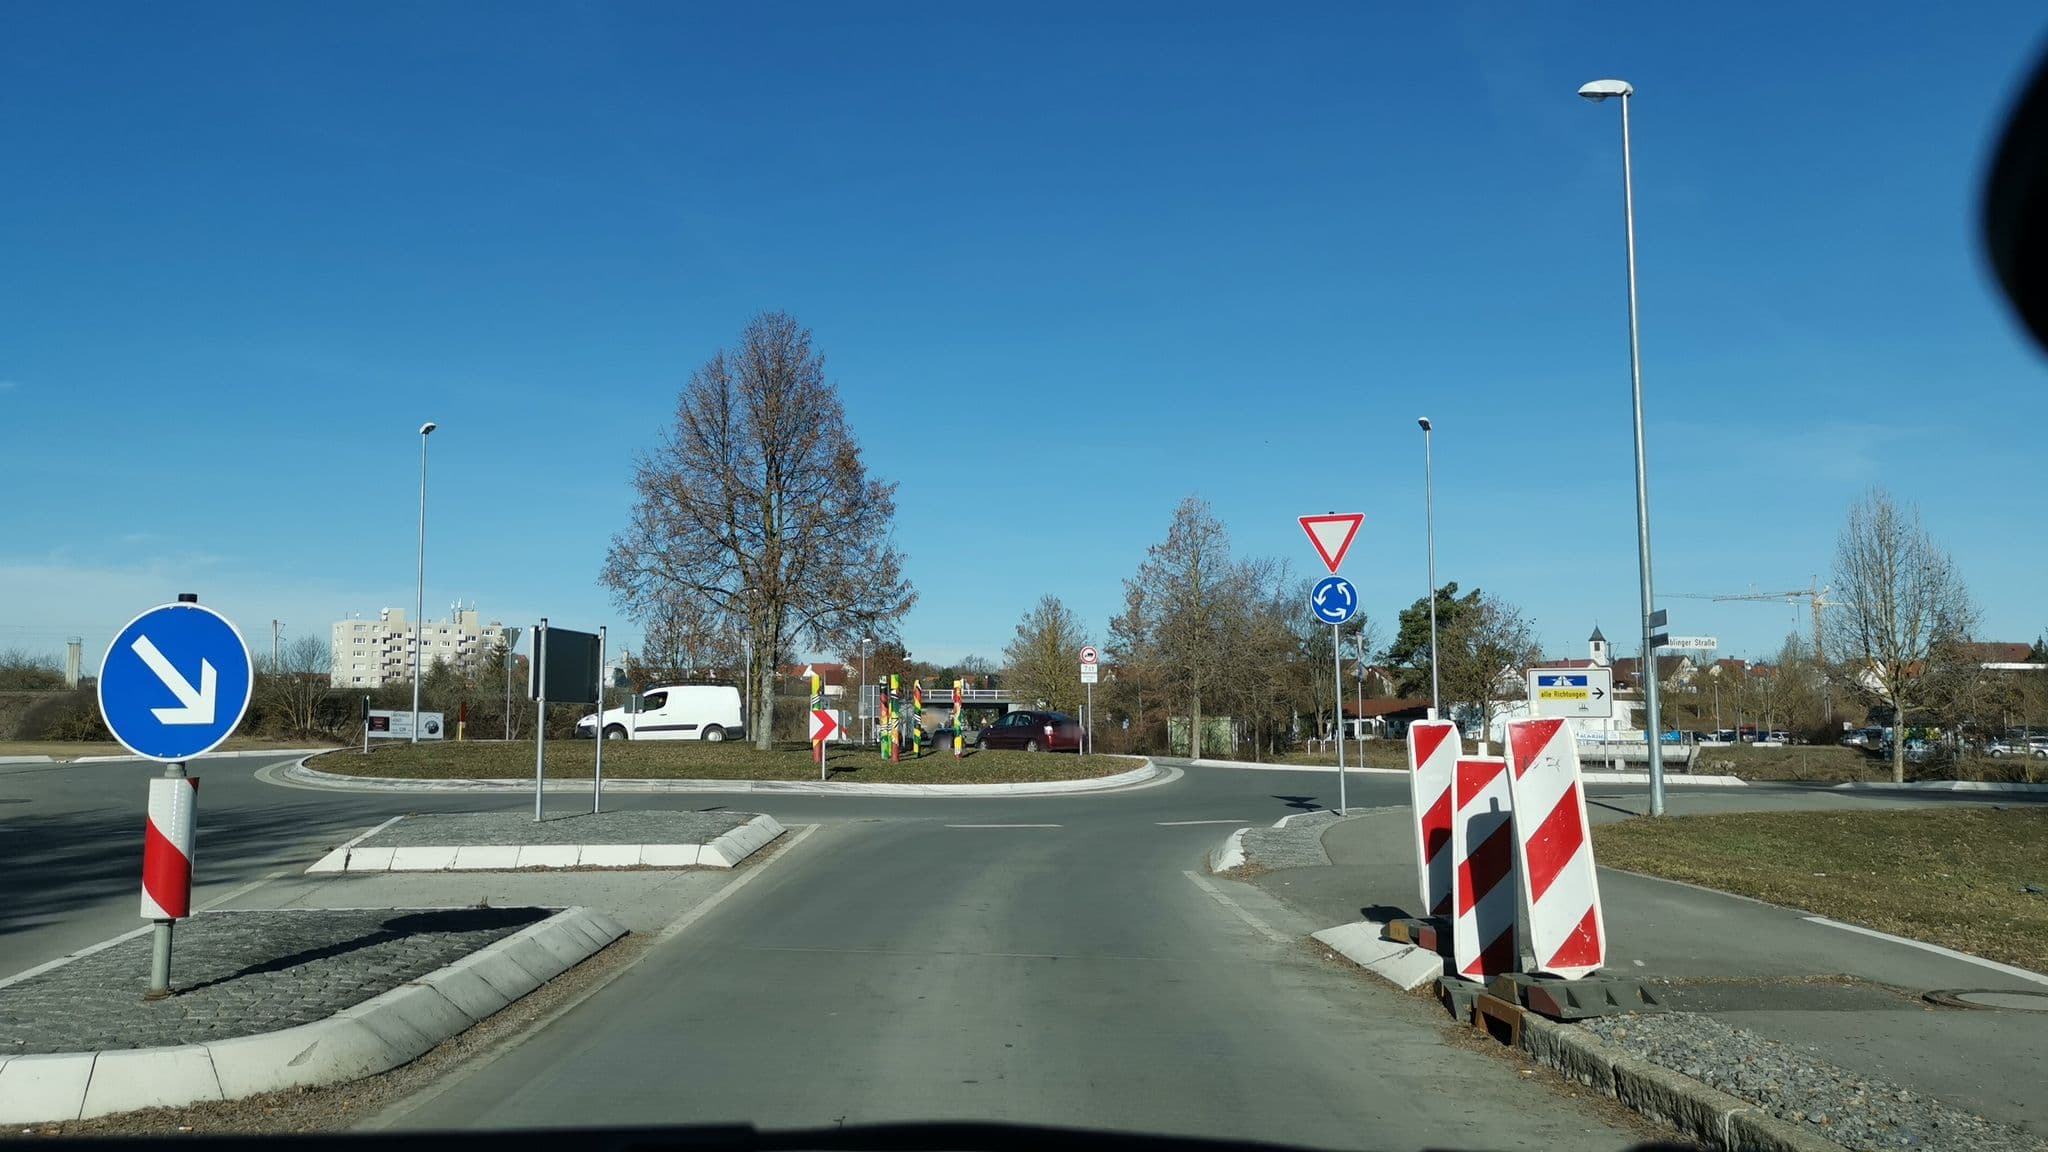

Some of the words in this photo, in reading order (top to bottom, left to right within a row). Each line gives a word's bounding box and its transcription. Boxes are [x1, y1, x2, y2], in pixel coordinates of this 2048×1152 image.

[1670, 638, 1691, 648] blinger
[1695, 638, 1715, 647] Straße
[1554, 691, 1586, 699] Richtungen
